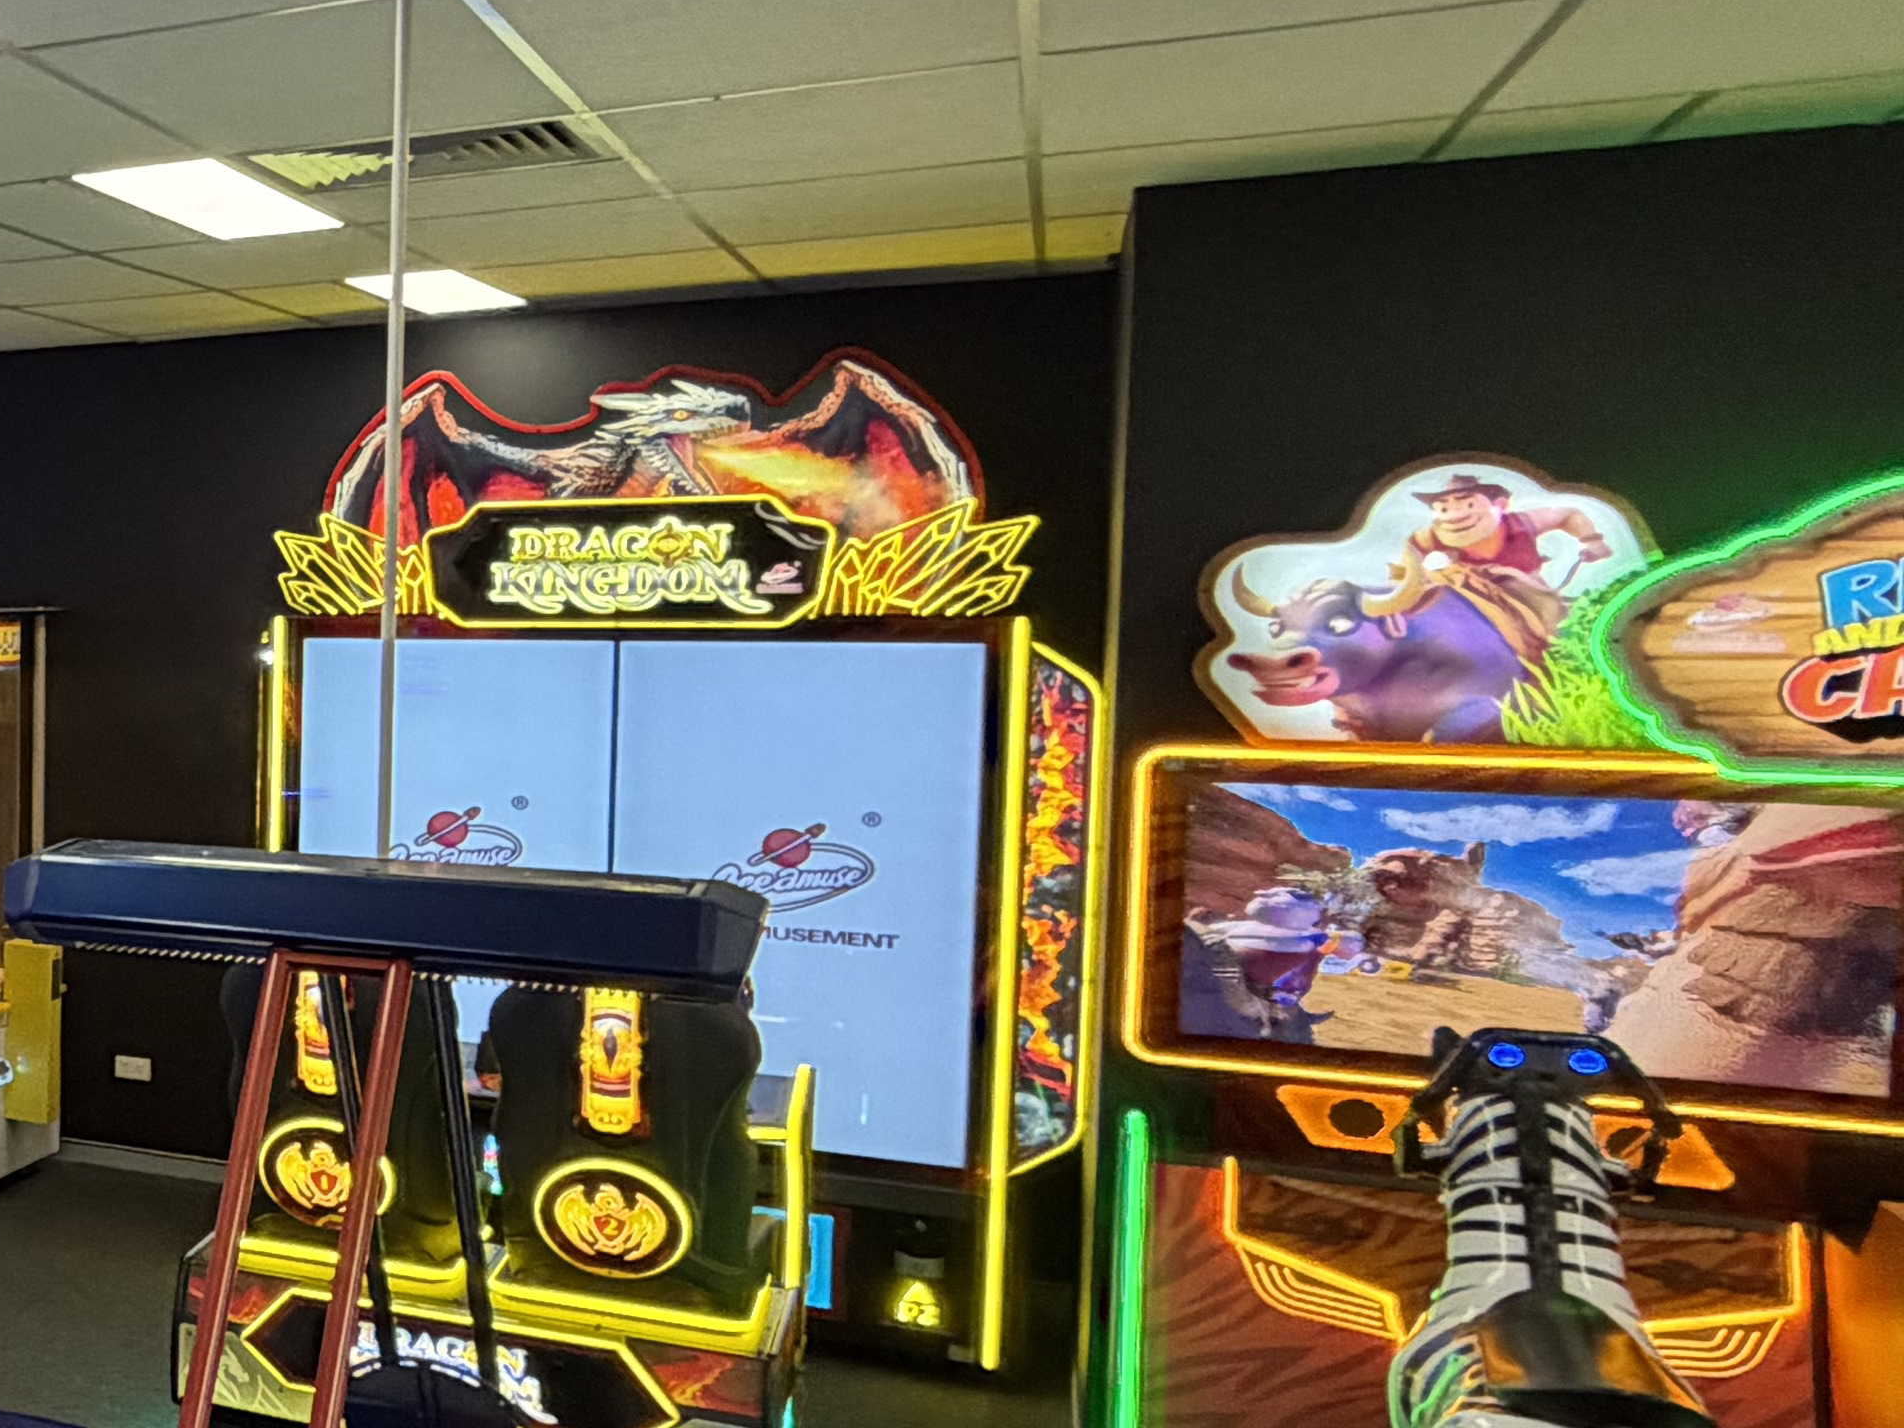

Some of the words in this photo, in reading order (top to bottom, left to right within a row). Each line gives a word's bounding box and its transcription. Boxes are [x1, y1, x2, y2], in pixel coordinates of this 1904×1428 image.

[508, 516, 734, 564] DRAGON
[489, 558, 774, 614] KINGDOM
[762, 925, 900, 949] USEMENT
